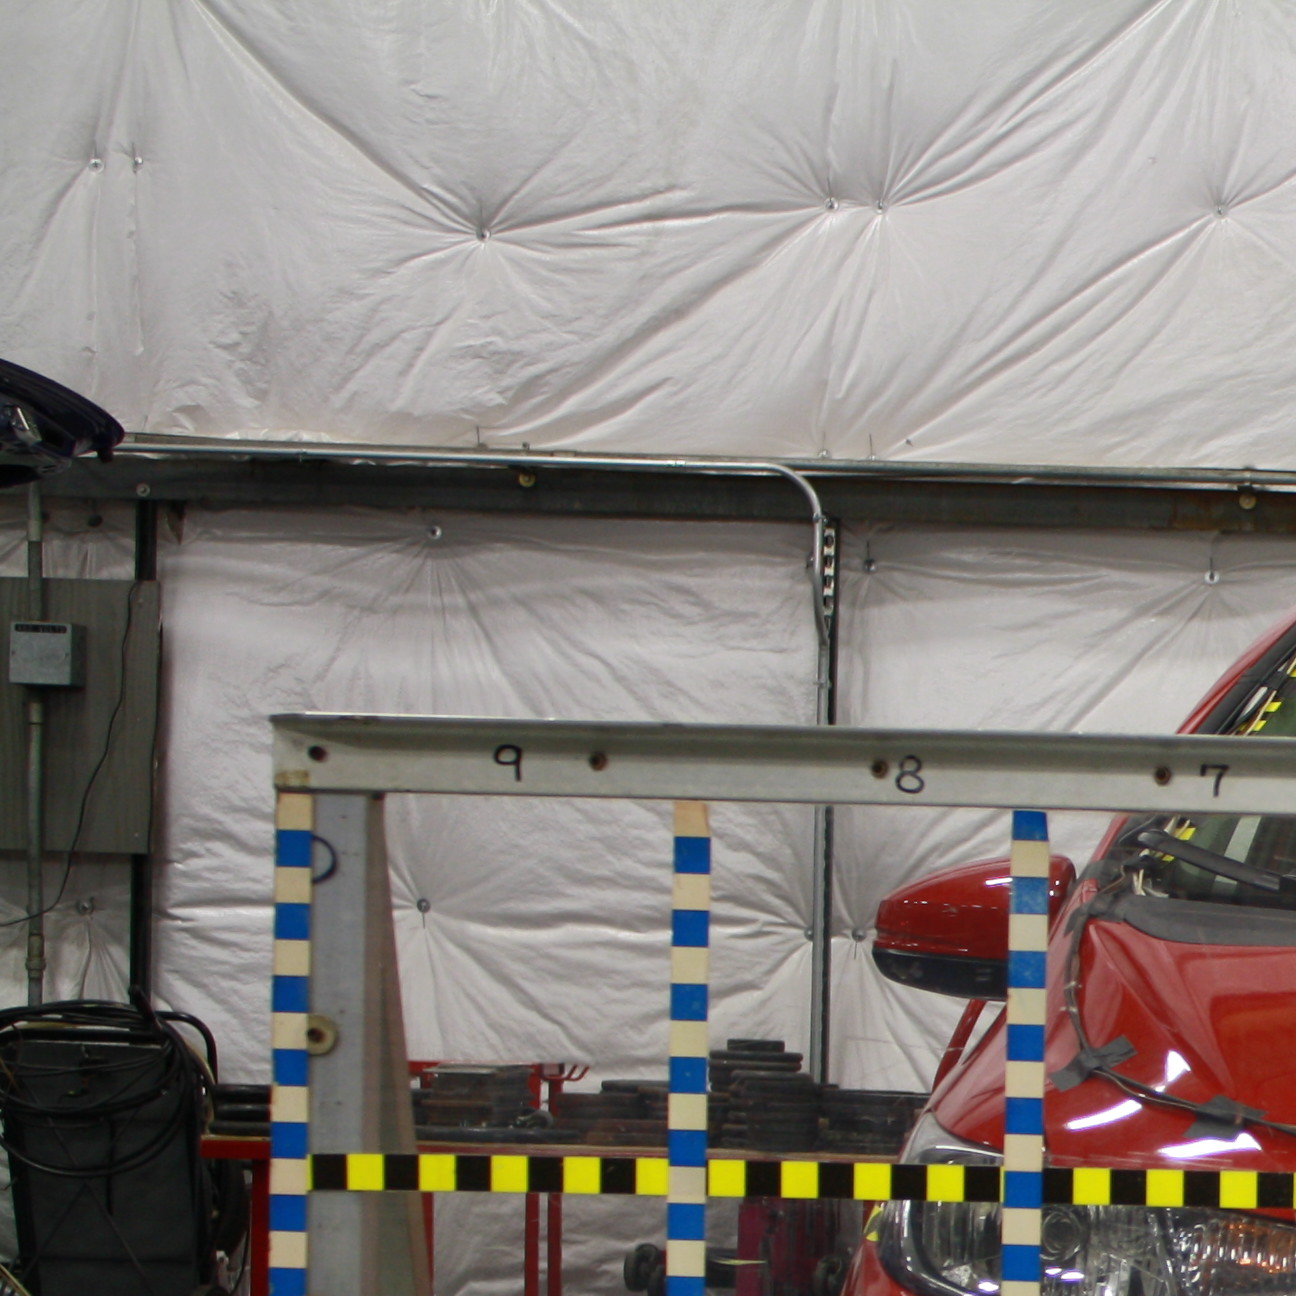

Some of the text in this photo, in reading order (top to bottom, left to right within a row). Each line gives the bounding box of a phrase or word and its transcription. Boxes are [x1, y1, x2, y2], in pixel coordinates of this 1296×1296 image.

[493, 743, 522, 782] 9
[895, 756, 925, 794] 8
[1200, 764, 1229, 798] 7
